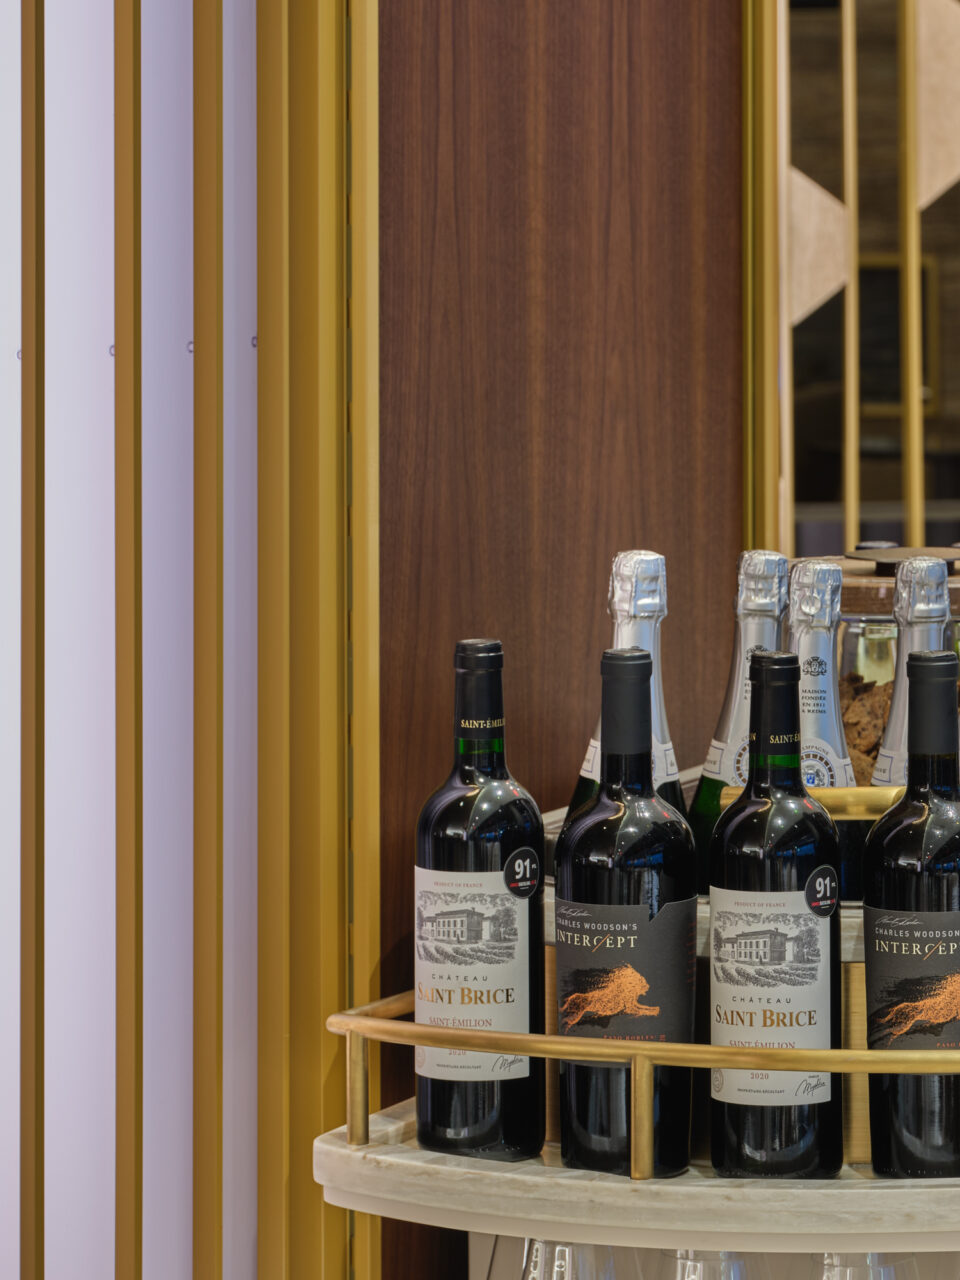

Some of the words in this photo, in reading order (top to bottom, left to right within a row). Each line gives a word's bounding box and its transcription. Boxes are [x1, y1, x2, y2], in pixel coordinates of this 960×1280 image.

[515, 858, 530, 879] 91
[815, 876, 830, 898] 91
[584, 921, 638, 931] WOODSON'S
[875, 927, 910, 938] CHARLES
[556, 928, 638, 949] INTERCEPT
[418, 981, 455, 1005] SAINT
[460, 986, 515, 1006] BRICE
[428, 1015, 492, 1028] SAINT-ÉMILION
[715, 1003, 757, 1028] SAINT
[761, 1008, 817, 1028] BRICE
[749, 1071, 770, 1081] 2020
